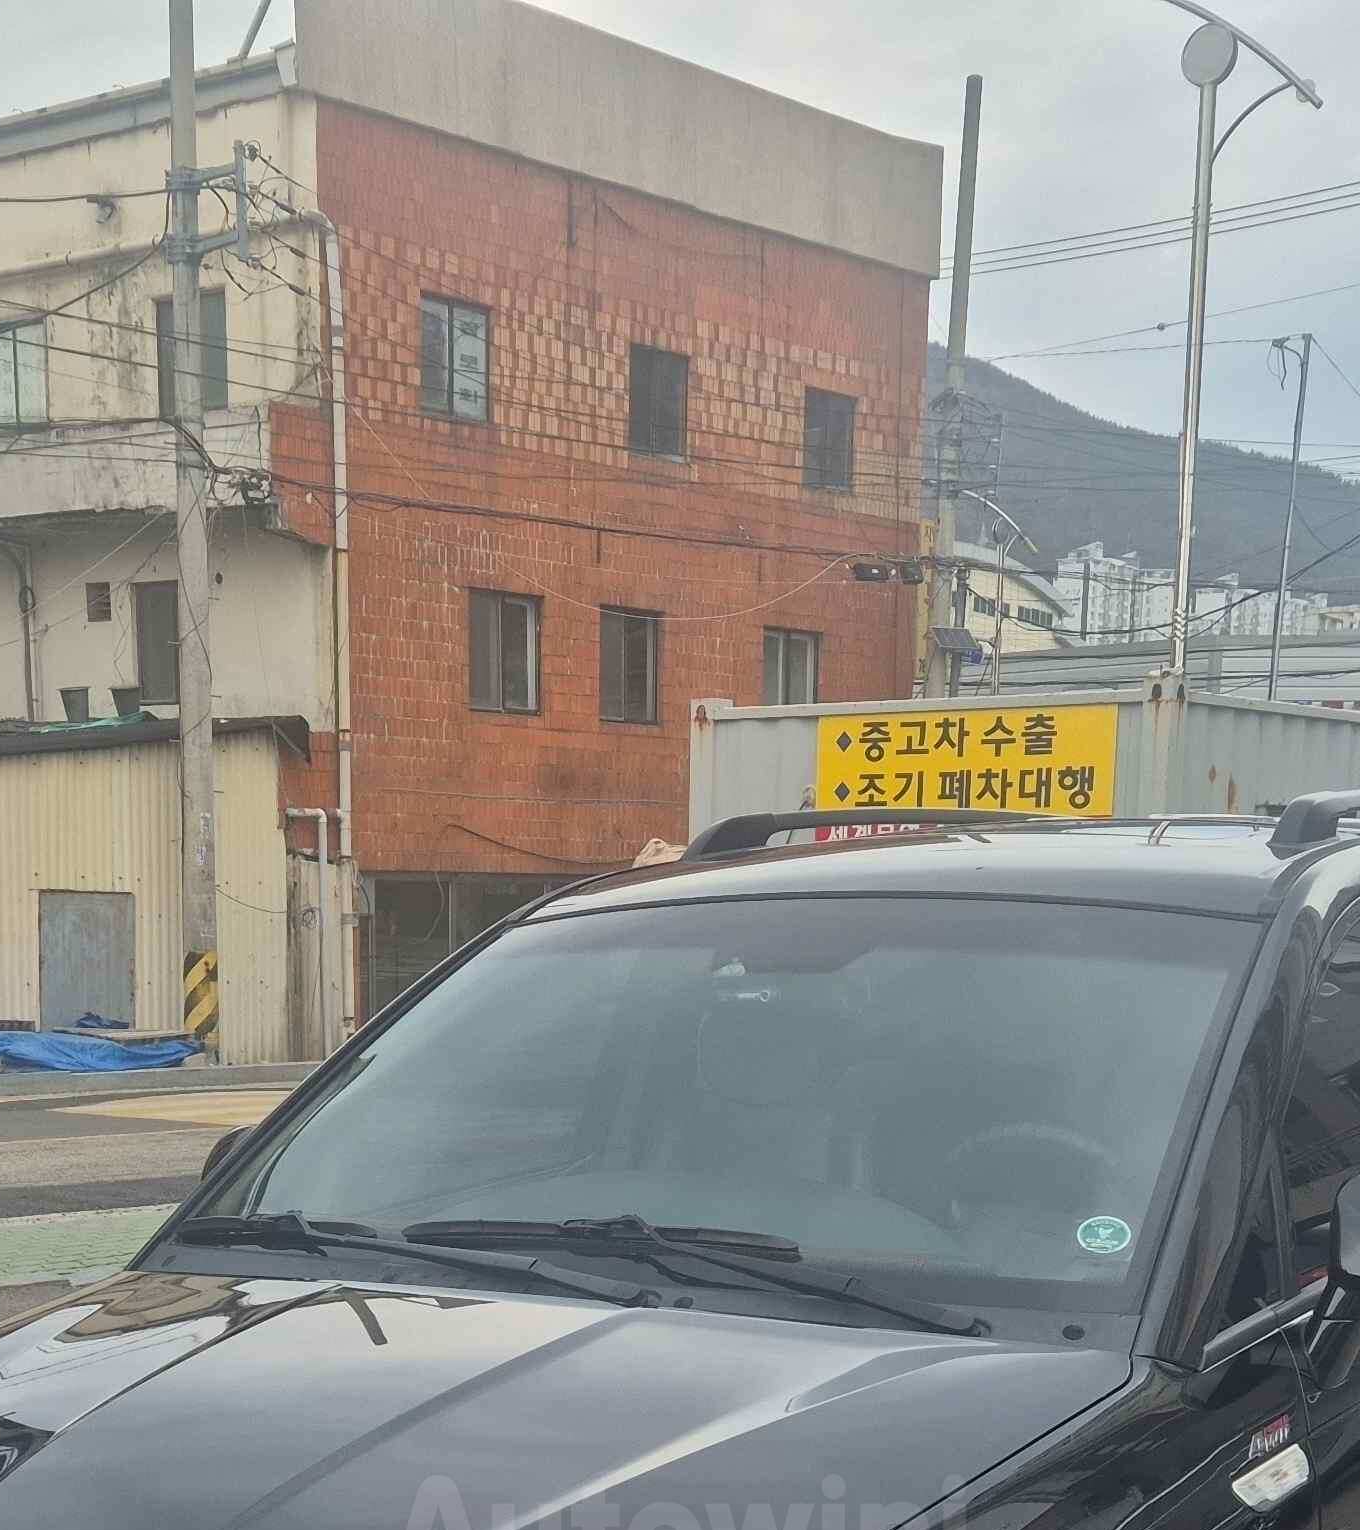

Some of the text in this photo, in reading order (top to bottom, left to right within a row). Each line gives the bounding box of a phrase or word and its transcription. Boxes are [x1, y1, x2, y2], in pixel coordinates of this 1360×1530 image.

[858, 713, 1058, 763] 중고차 수출
[854, 765, 1096, 810] 조기 폐차대행
